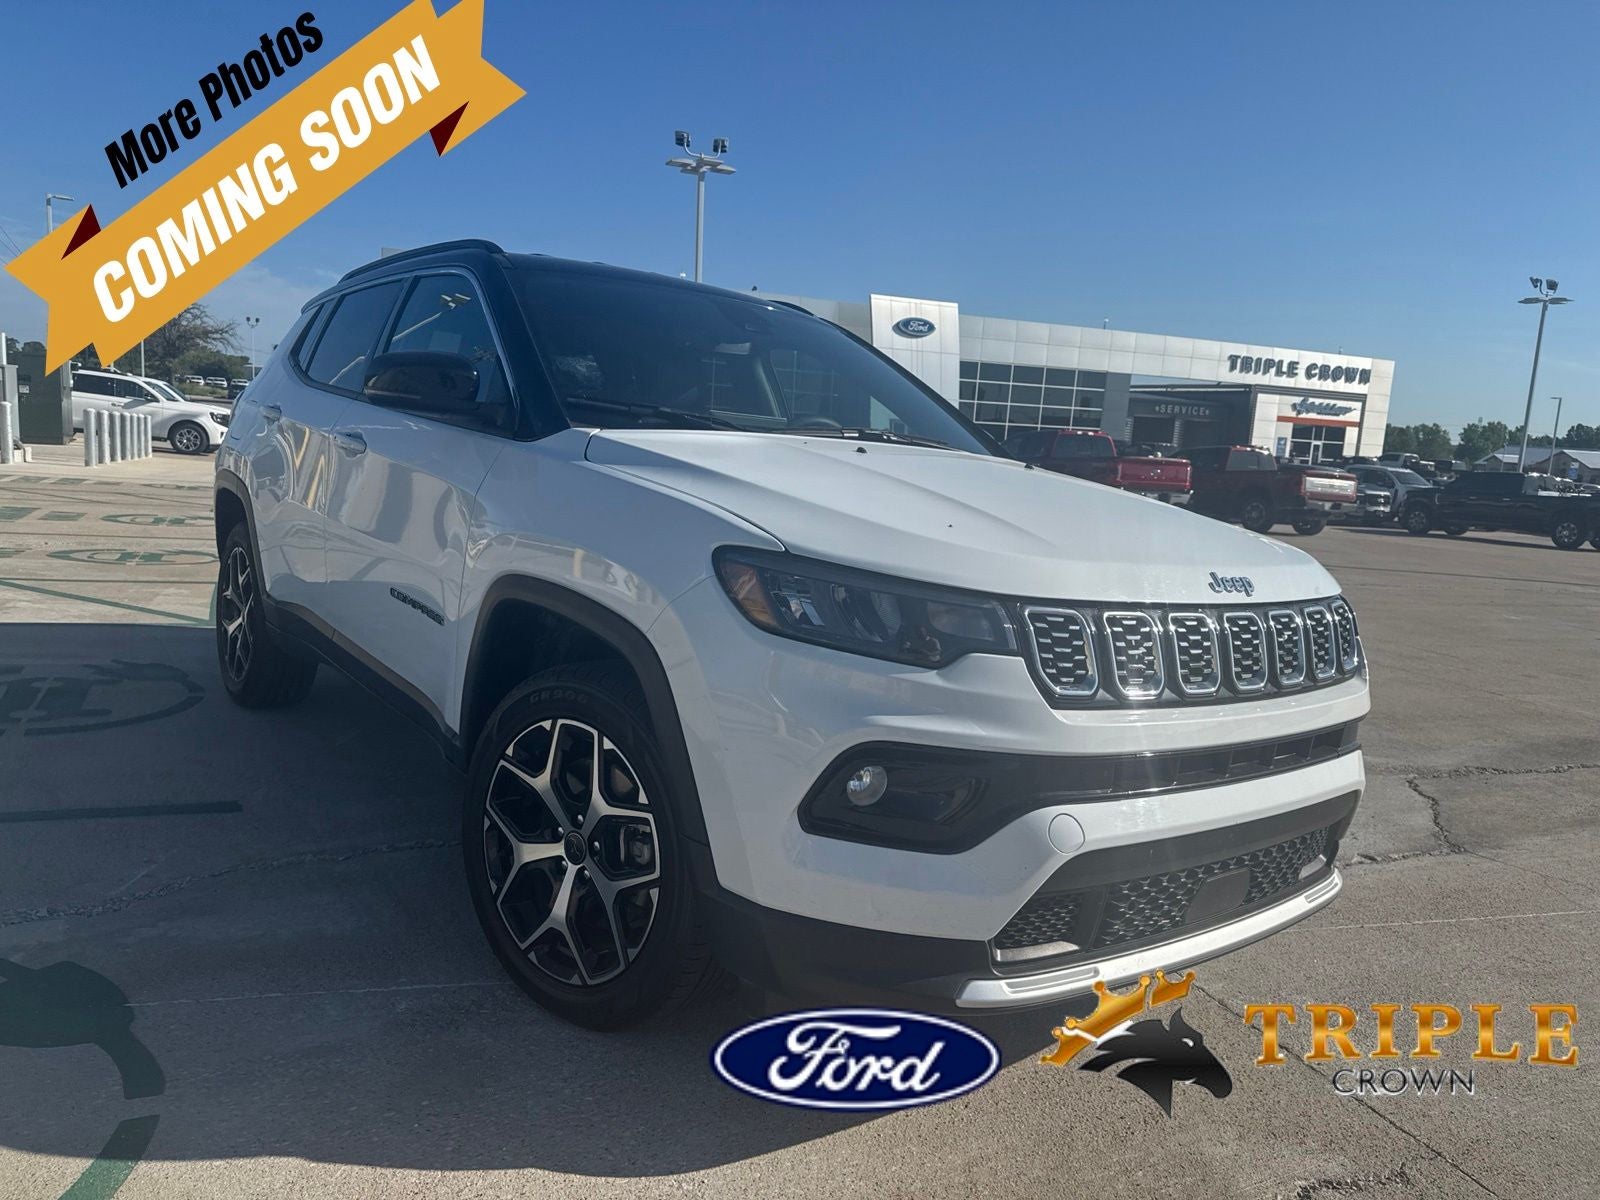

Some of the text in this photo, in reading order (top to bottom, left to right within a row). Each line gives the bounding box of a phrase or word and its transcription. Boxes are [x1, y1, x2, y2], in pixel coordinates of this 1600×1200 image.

[1228, 354, 1371, 385] TRIPLE CROWN
[1160, 404, 1205, 416] SERVICE
[1208, 571, 1254, 597] Jeep
